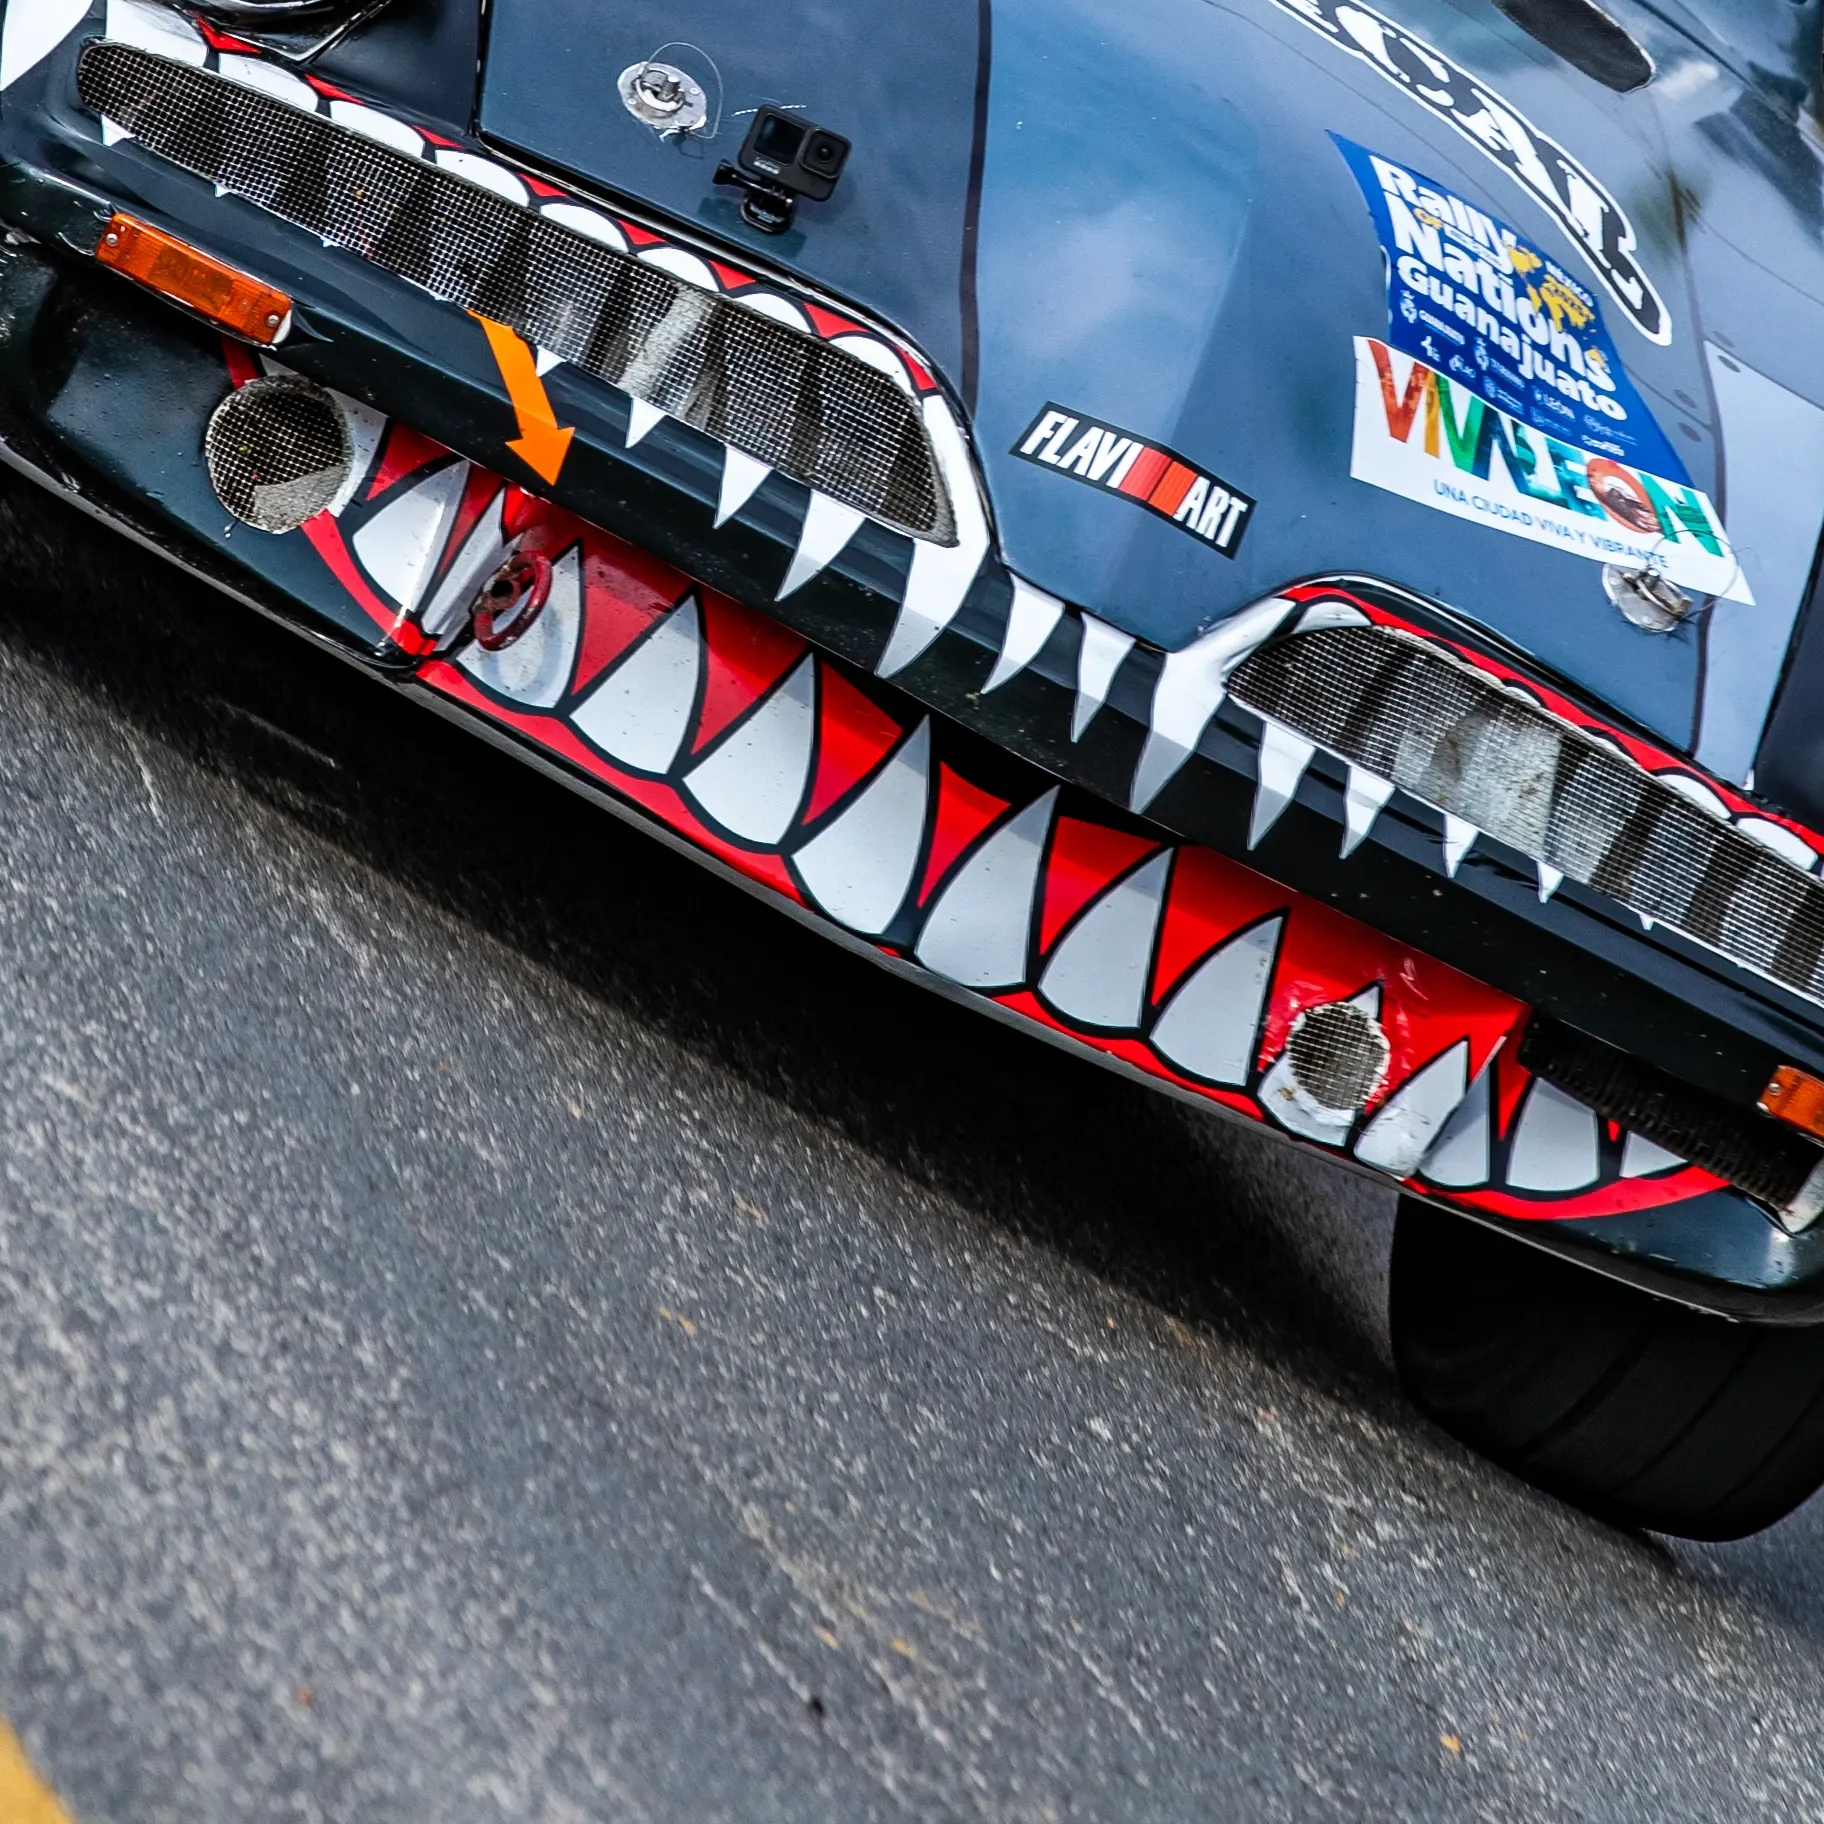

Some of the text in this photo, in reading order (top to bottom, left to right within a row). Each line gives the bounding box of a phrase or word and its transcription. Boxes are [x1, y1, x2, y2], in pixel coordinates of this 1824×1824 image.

[1369, 155, 1517, 275] Rally
[1383, 190, 1617, 392] Nations
[1396, 255, 1628, 421] Guanajuato
[1019, 409, 1249, 548] FLAVI ART
[1433, 478, 1670, 570] UNA CIUDAD VIVA Y VIBRANTE
